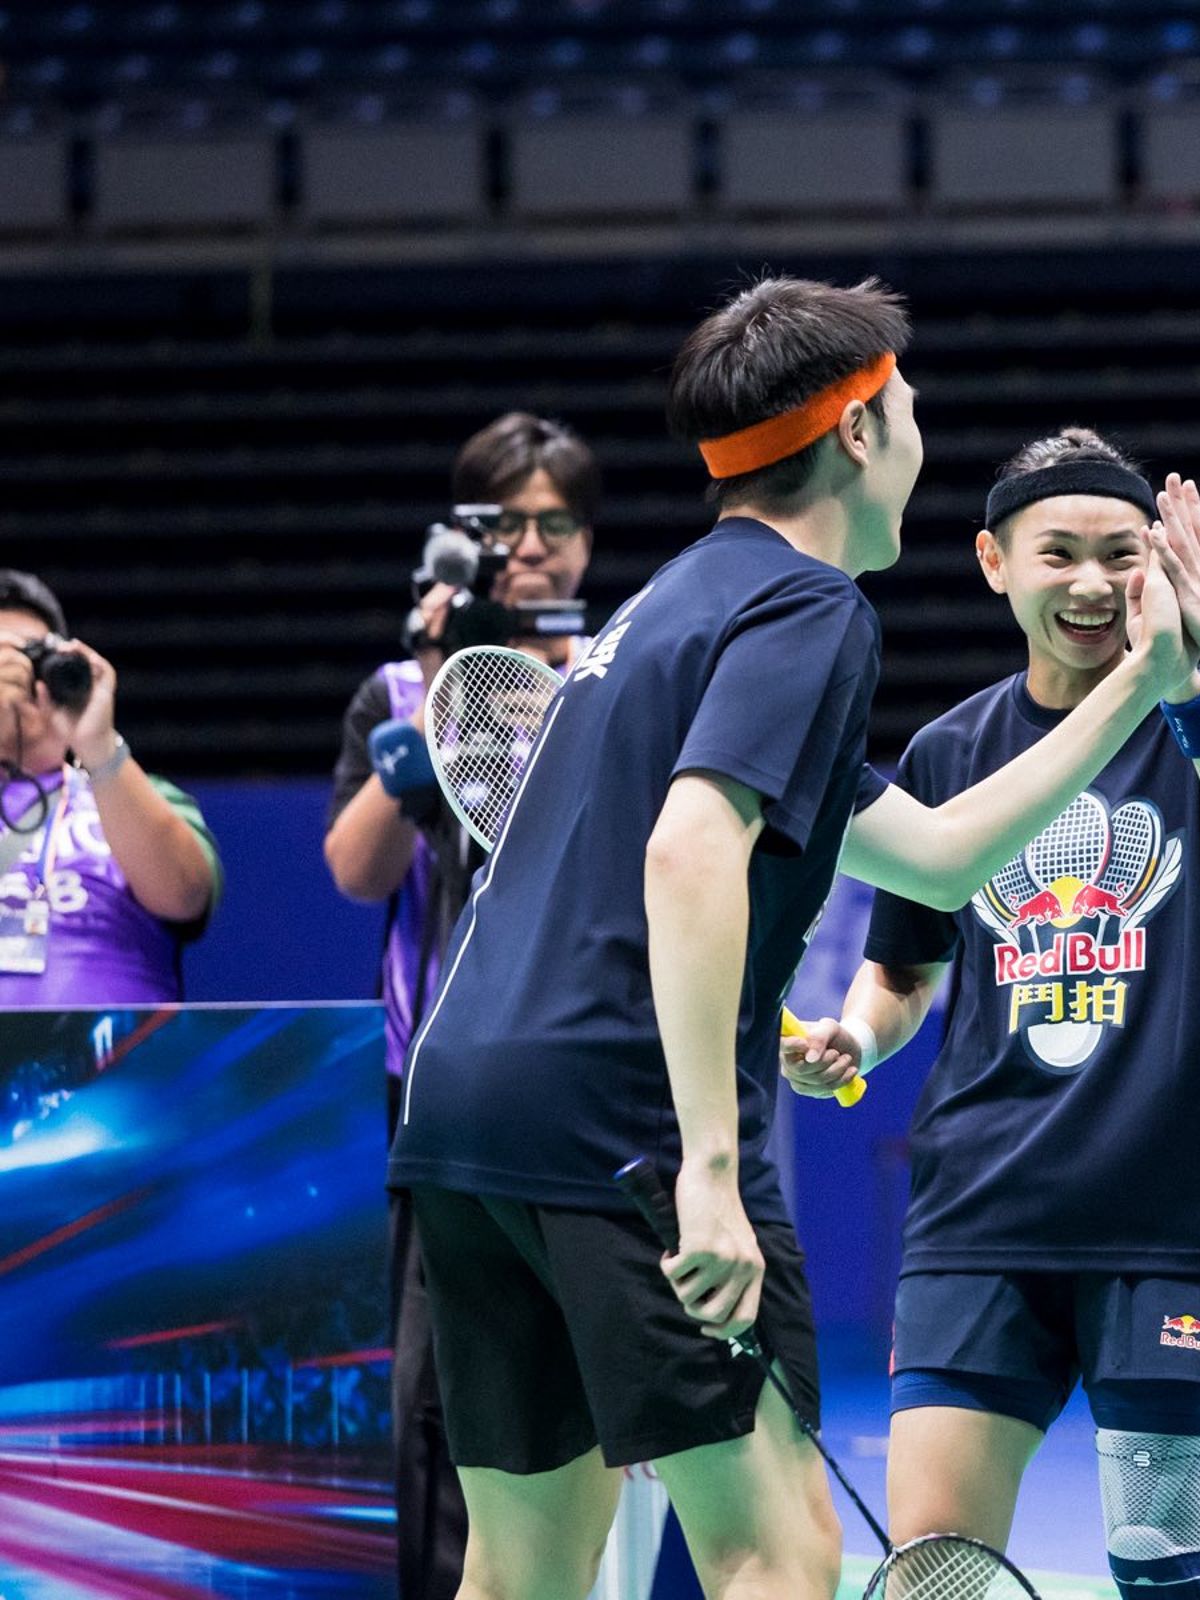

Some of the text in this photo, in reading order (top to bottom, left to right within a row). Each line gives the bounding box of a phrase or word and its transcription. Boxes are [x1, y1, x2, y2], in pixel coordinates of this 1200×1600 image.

[994, 927, 1146, 986] Red Bull
[1160, 1332, 1185, 1347] Red
